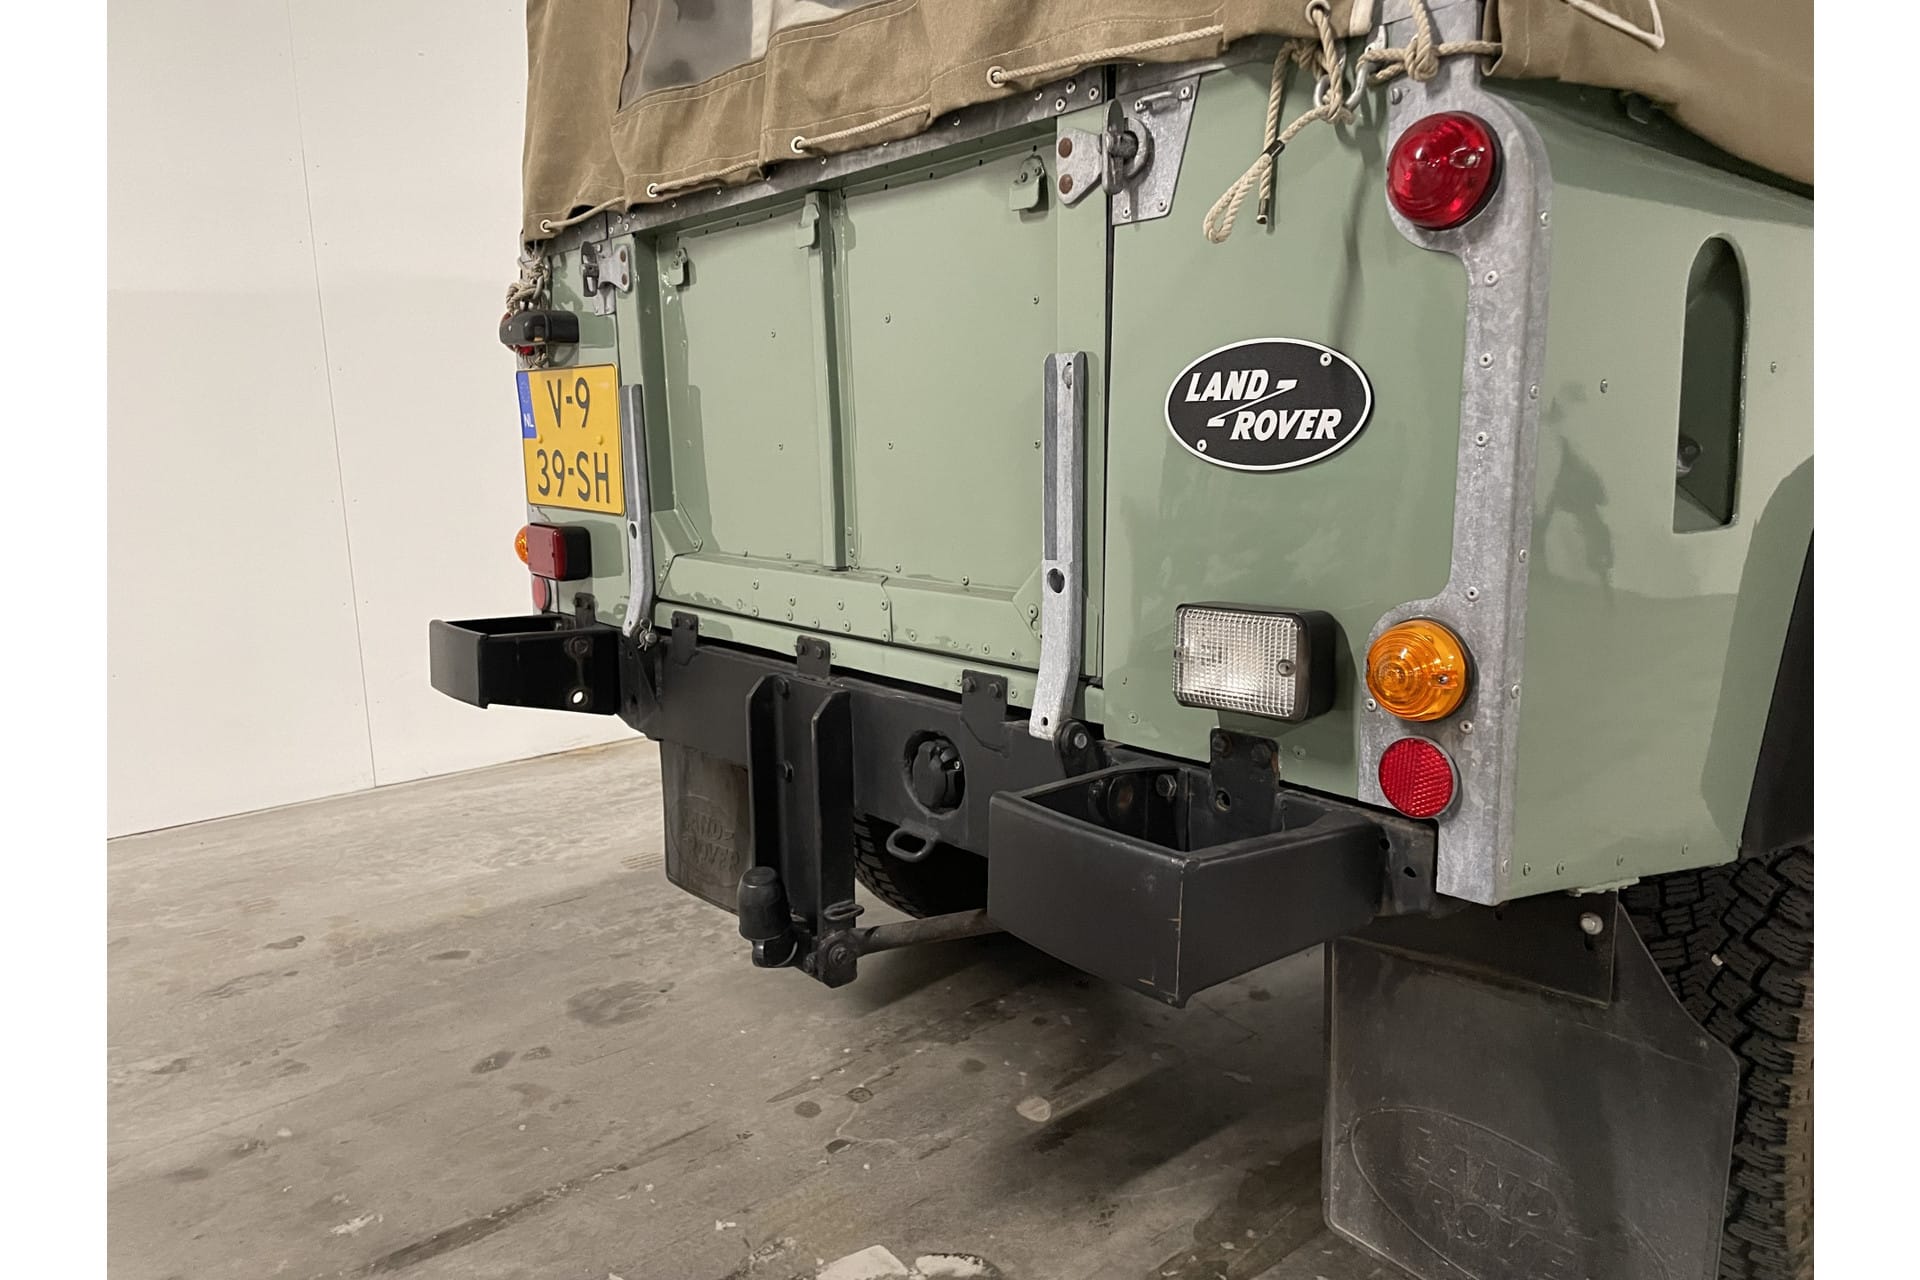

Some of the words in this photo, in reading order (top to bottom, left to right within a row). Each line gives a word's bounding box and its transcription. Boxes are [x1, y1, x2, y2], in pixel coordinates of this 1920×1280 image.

[1184, 369, 1270, 402] LAND
[546, 376, 591, 429] V-9
[523, 413, 535, 428] NL
[1229, 408, 1343, 441] ROVER
[536, 448, 611, 504] 39-SH
